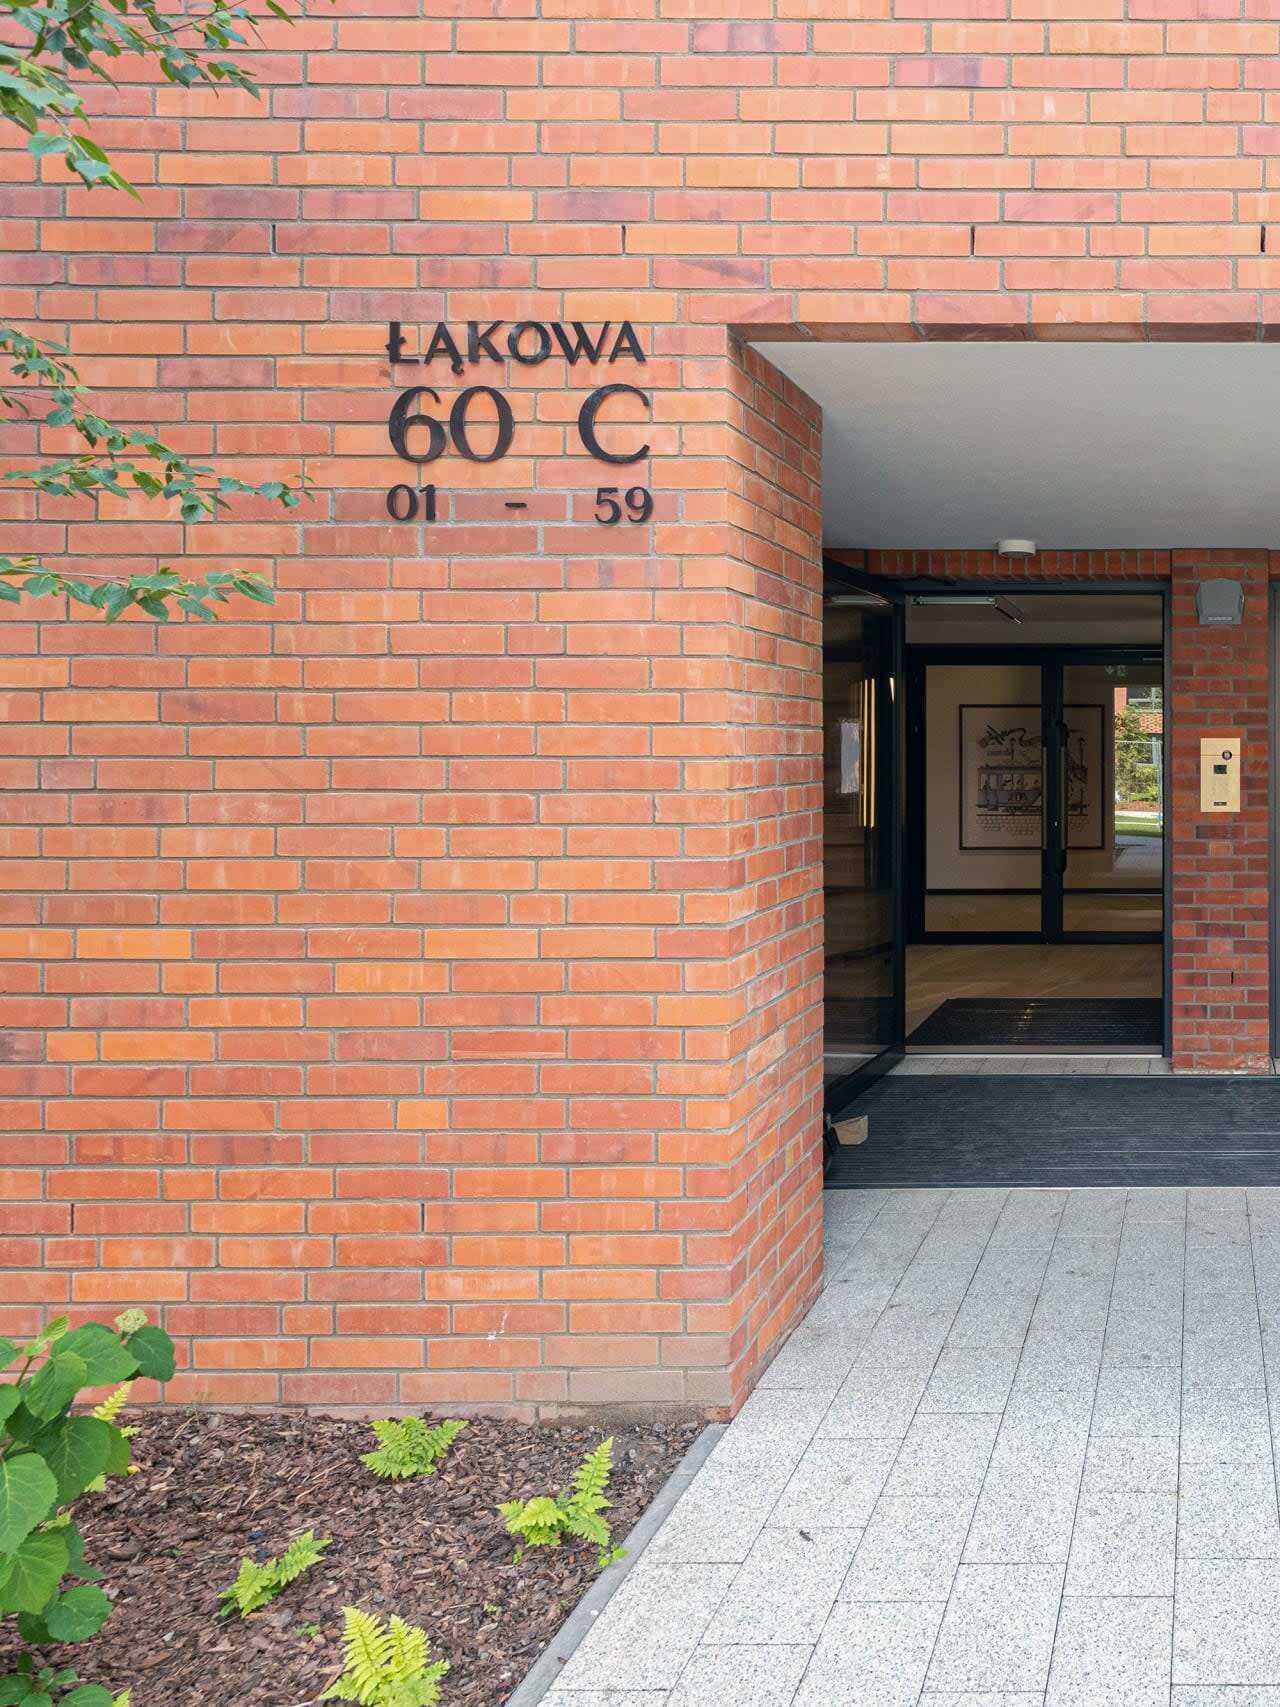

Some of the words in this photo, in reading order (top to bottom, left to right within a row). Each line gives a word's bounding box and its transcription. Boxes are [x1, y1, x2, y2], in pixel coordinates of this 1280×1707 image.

[386, 320, 646, 375] ŁĄKOWA
[389, 385, 514, 464] 60
[578, 383, 650, 464] C
[386, 484, 437, 522] 01
[594, 486, 654, 524] 59
